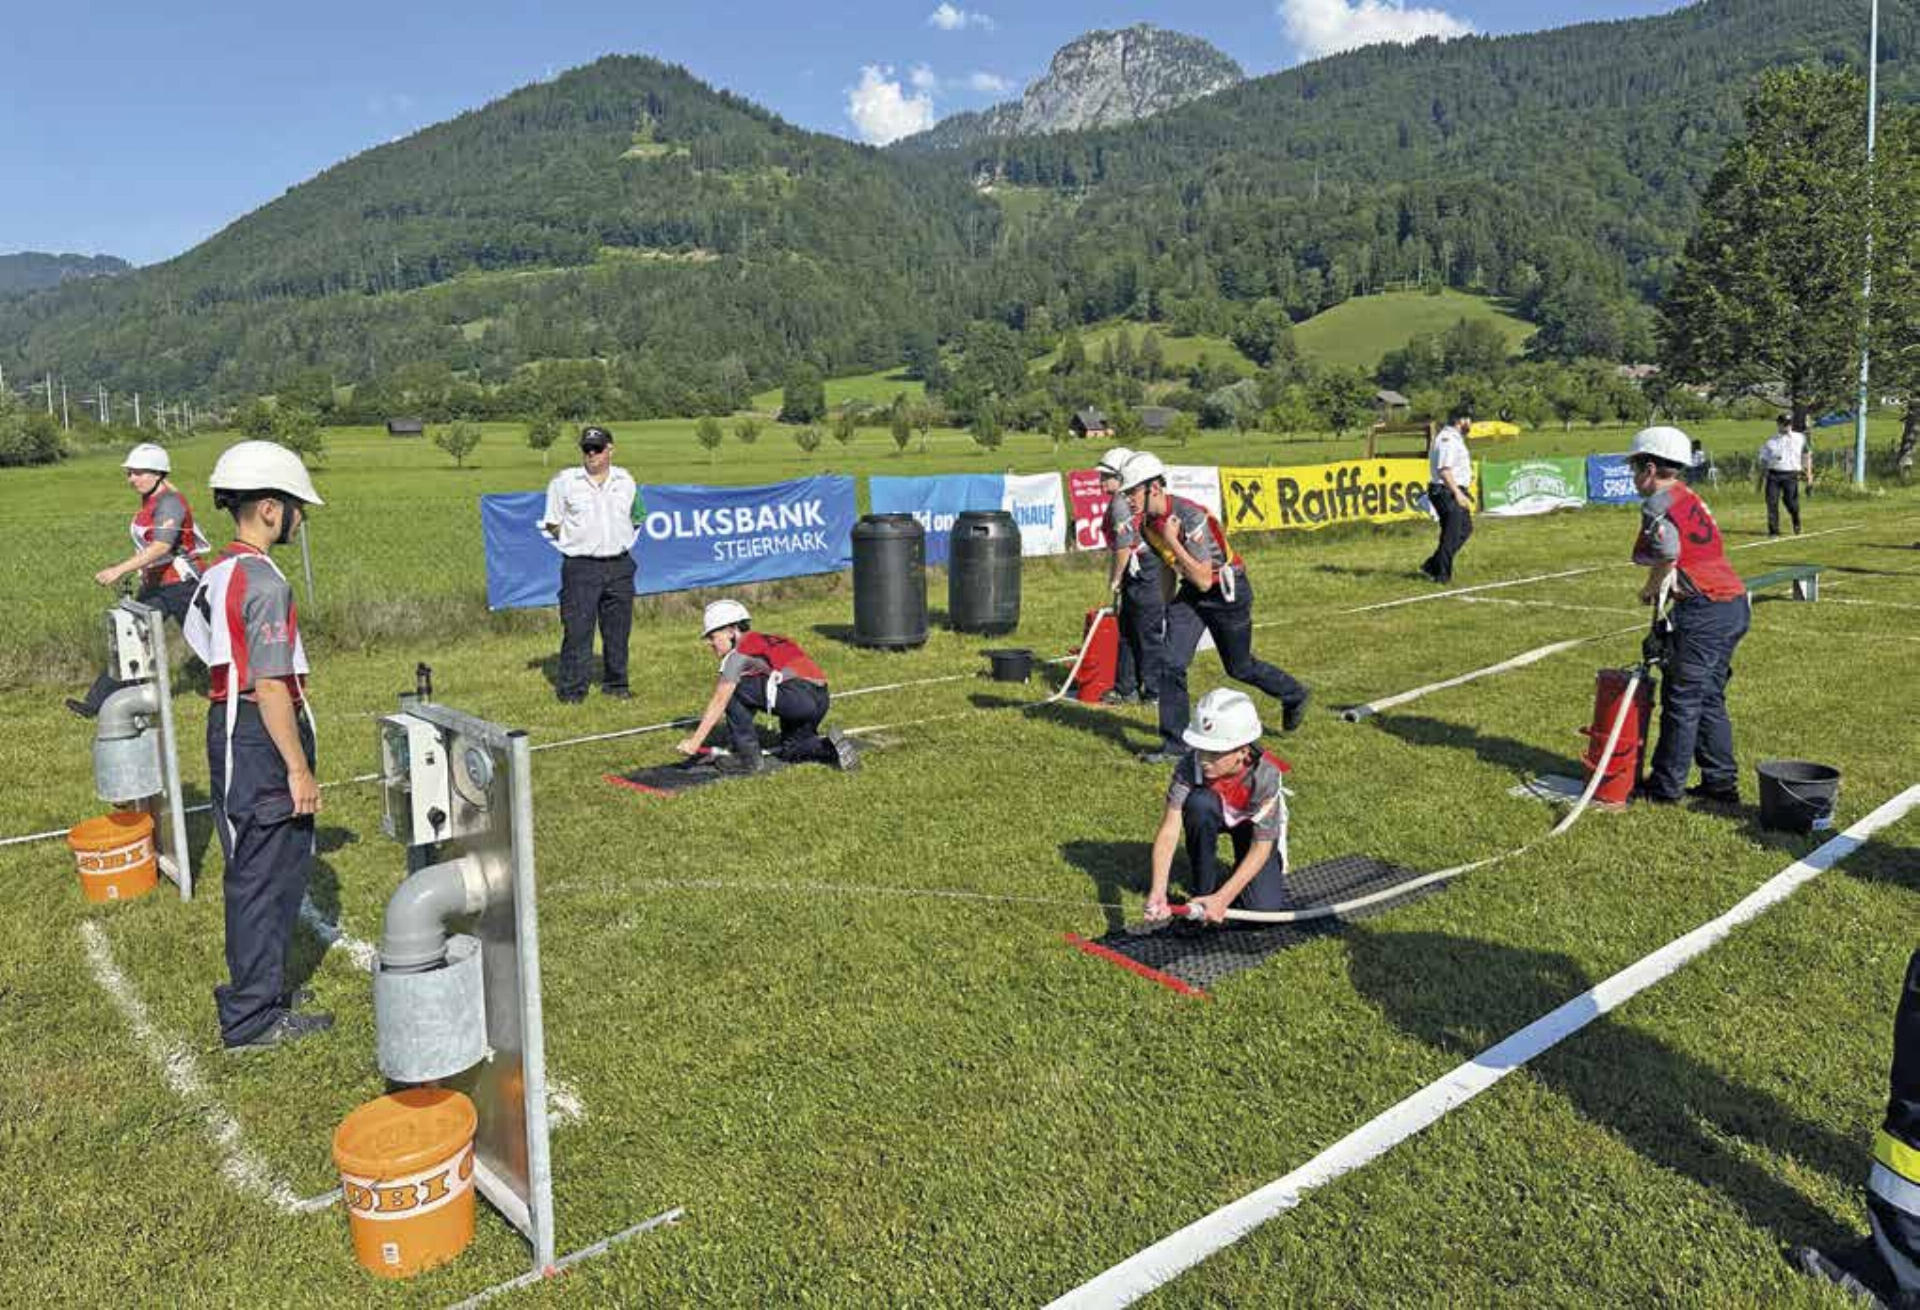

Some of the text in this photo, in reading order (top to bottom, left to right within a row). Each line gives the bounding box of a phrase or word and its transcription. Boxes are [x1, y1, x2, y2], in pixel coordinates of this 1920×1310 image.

[1277, 466, 1425, 525] Raiffeise
[645, 499, 827, 540] OLKSBANK
[713, 530, 829, 562] STEIERMARK
[345, 1168, 451, 1213] OBI
